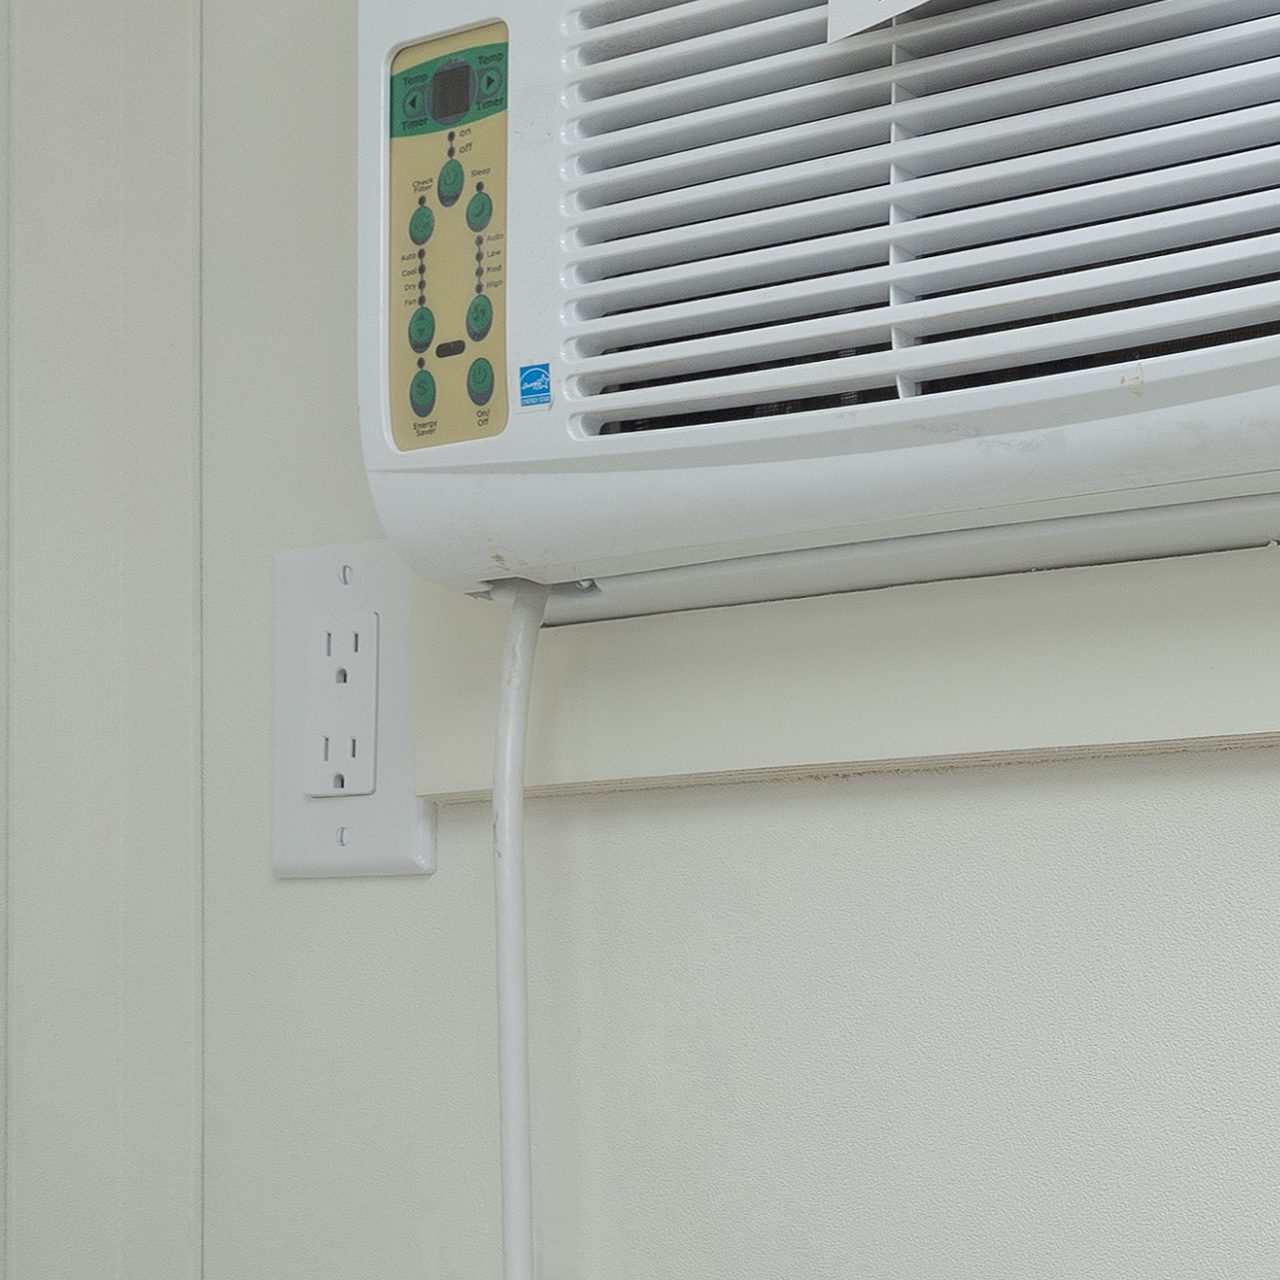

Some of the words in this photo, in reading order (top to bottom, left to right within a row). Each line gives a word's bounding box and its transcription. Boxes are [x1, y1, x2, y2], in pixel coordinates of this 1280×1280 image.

[478, 53, 504, 65] Temp
[403, 74, 428, 86] Temp
[471, 168, 491, 177] Sleep
[413, 421, 437, 431] Energy
[416, 427, 437, 437] Saver
